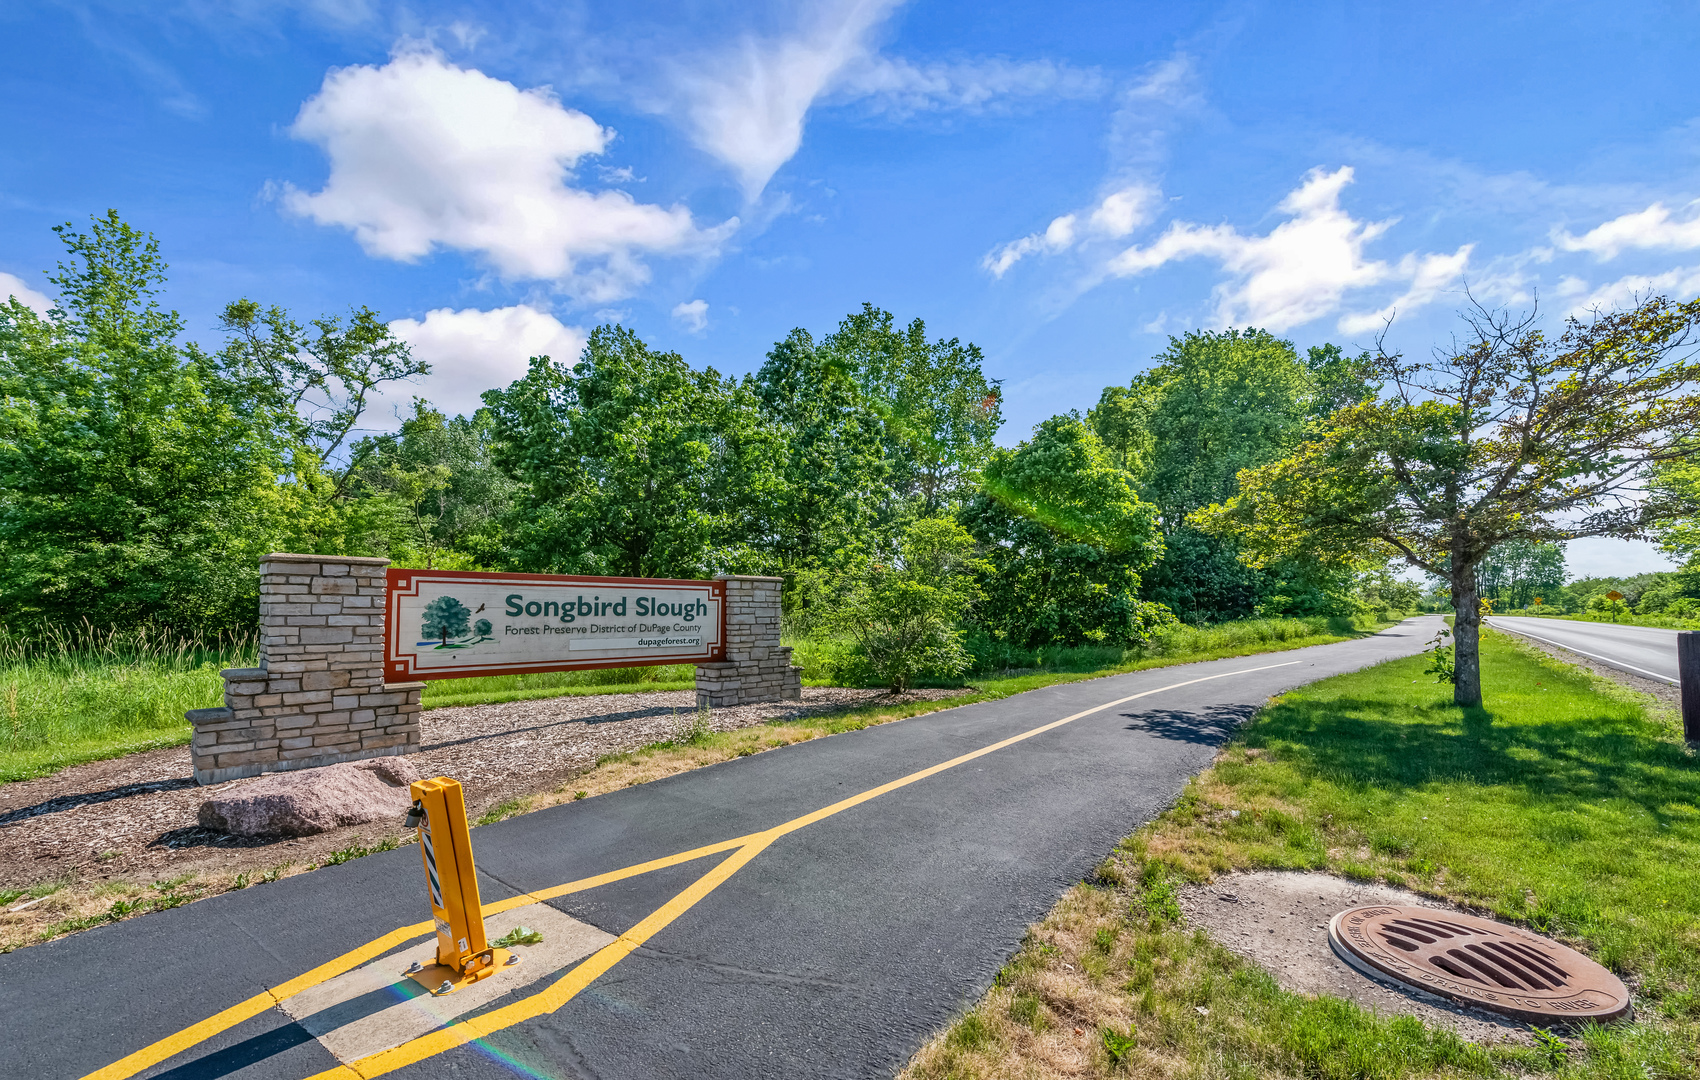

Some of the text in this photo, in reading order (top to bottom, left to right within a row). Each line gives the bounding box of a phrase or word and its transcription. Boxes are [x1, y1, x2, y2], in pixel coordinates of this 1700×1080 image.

[505, 594, 707, 622] Songbird Slough
[505, 623, 702, 635] Forest Preserve District of DuPage County
[638, 637, 700, 647] dupageforest.org
[1347, 925, 1374, 949] WASTE
[1420, 973, 1499, 1001] DRAINS
[1508, 996, 1542, 1009] TO
[1546, 998, 1601, 1011] RIVER
